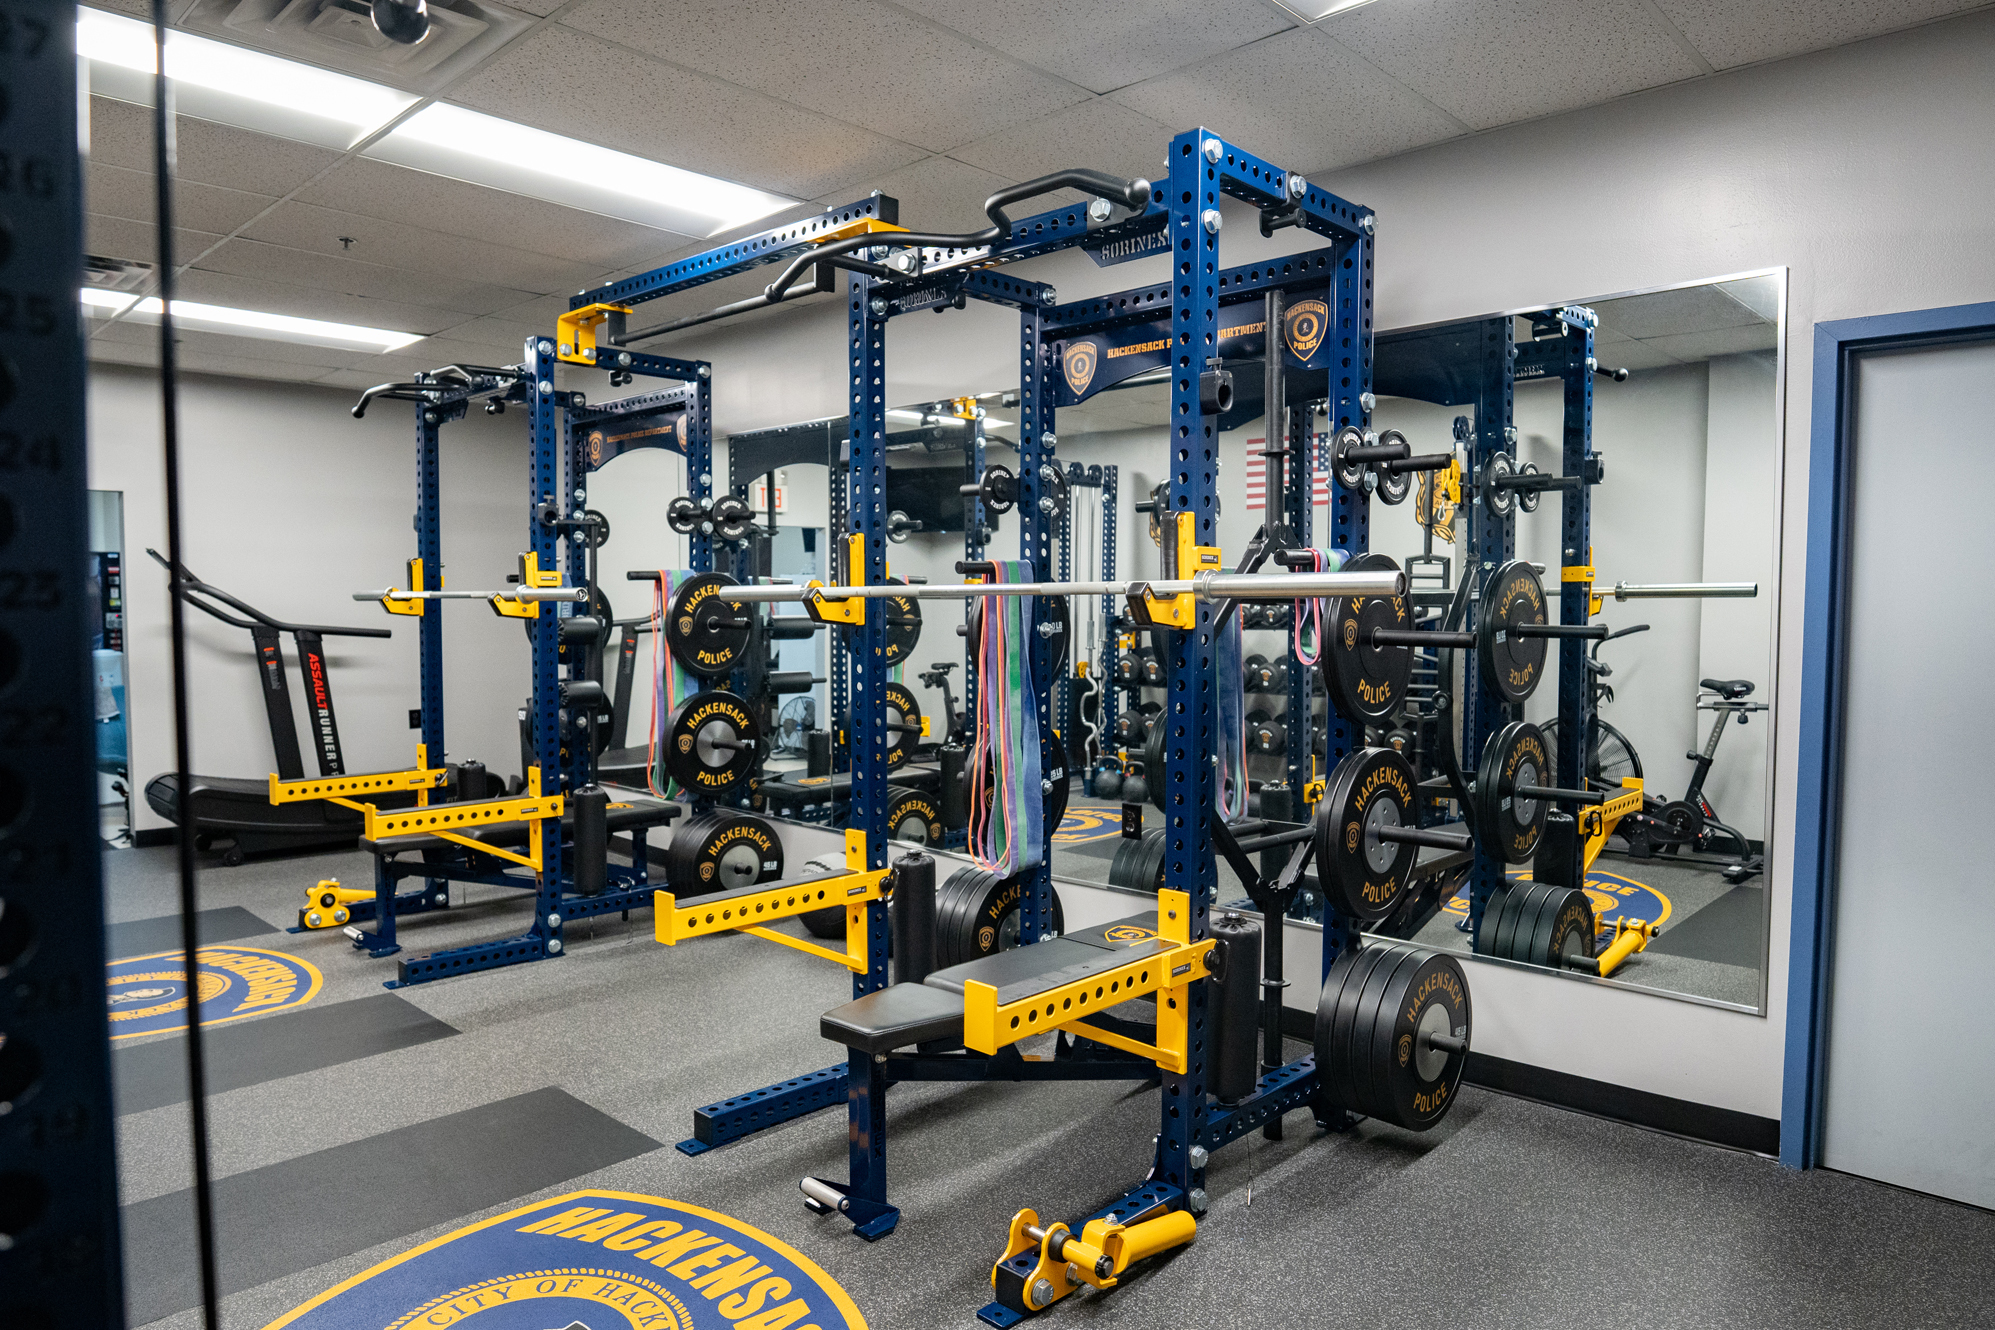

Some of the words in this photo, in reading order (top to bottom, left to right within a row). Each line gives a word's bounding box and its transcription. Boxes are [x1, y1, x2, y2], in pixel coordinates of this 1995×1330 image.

[1101, 232, 1167, 260] SORINEX
[1286, 303, 1325, 321] HACKENSACK
[1107, 339, 1165, 359] HACKENSACK
[1293, 338, 1317, 350] POLICE
[684, 584, 742, 613] HACKENK
[697, 647, 733, 664] POLICE
[1357, 678, 1391, 704] POLICE
[686, 702, 750, 730] HACKENSACK
[696, 769, 735, 786] POLICE
[1354, 766, 1412, 812] HACKENSACK
[708, 826, 772, 857] HACKENSACK
[1361, 876, 1397, 903] POLICE
[1406, 971, 1463, 1023] HACKENSACK
[1413, 1081, 1448, 1113] POLICE
[515, 1207, 822, 1330] HACKENSA
[427, 1285, 513, 1326] CITY
[535, 1279, 583, 1294] OF
